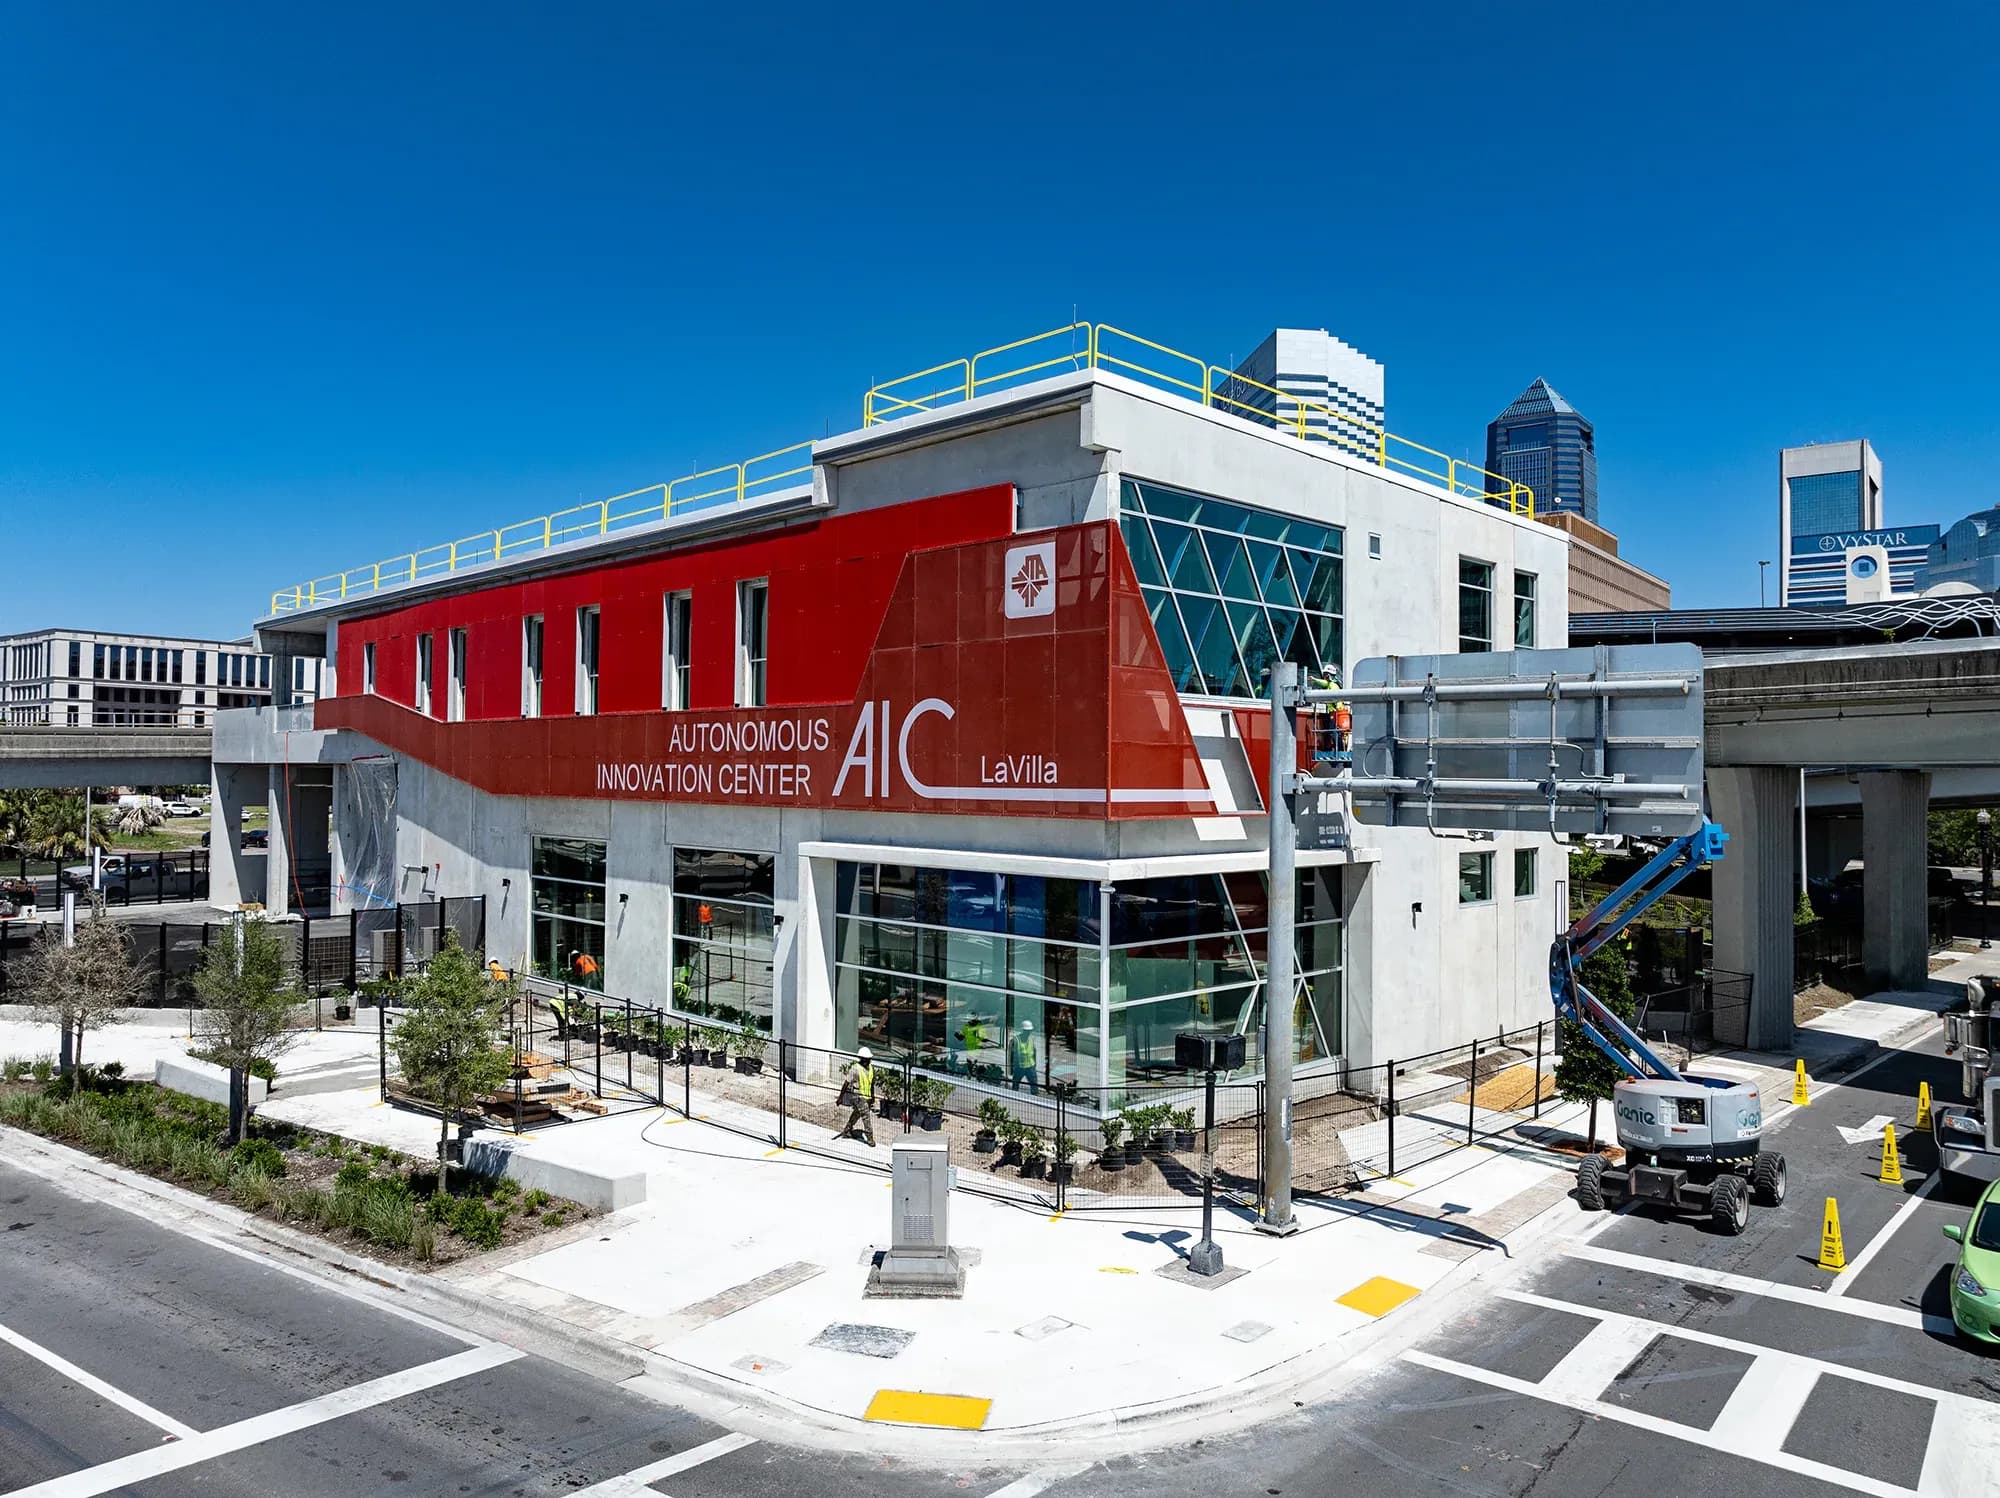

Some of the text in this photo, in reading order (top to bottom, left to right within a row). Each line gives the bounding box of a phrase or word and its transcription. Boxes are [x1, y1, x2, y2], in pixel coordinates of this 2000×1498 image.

[668, 718, 829, 753] AUTONOMOUS
[831, 697, 956, 799] AIC
[597, 763, 812, 796] INNOVATION CENTER
[981, 754, 1058, 784] LaVilla
[1617, 1099, 1656, 1126] Genie
[1736, 1108, 1761, 1128] Gen
